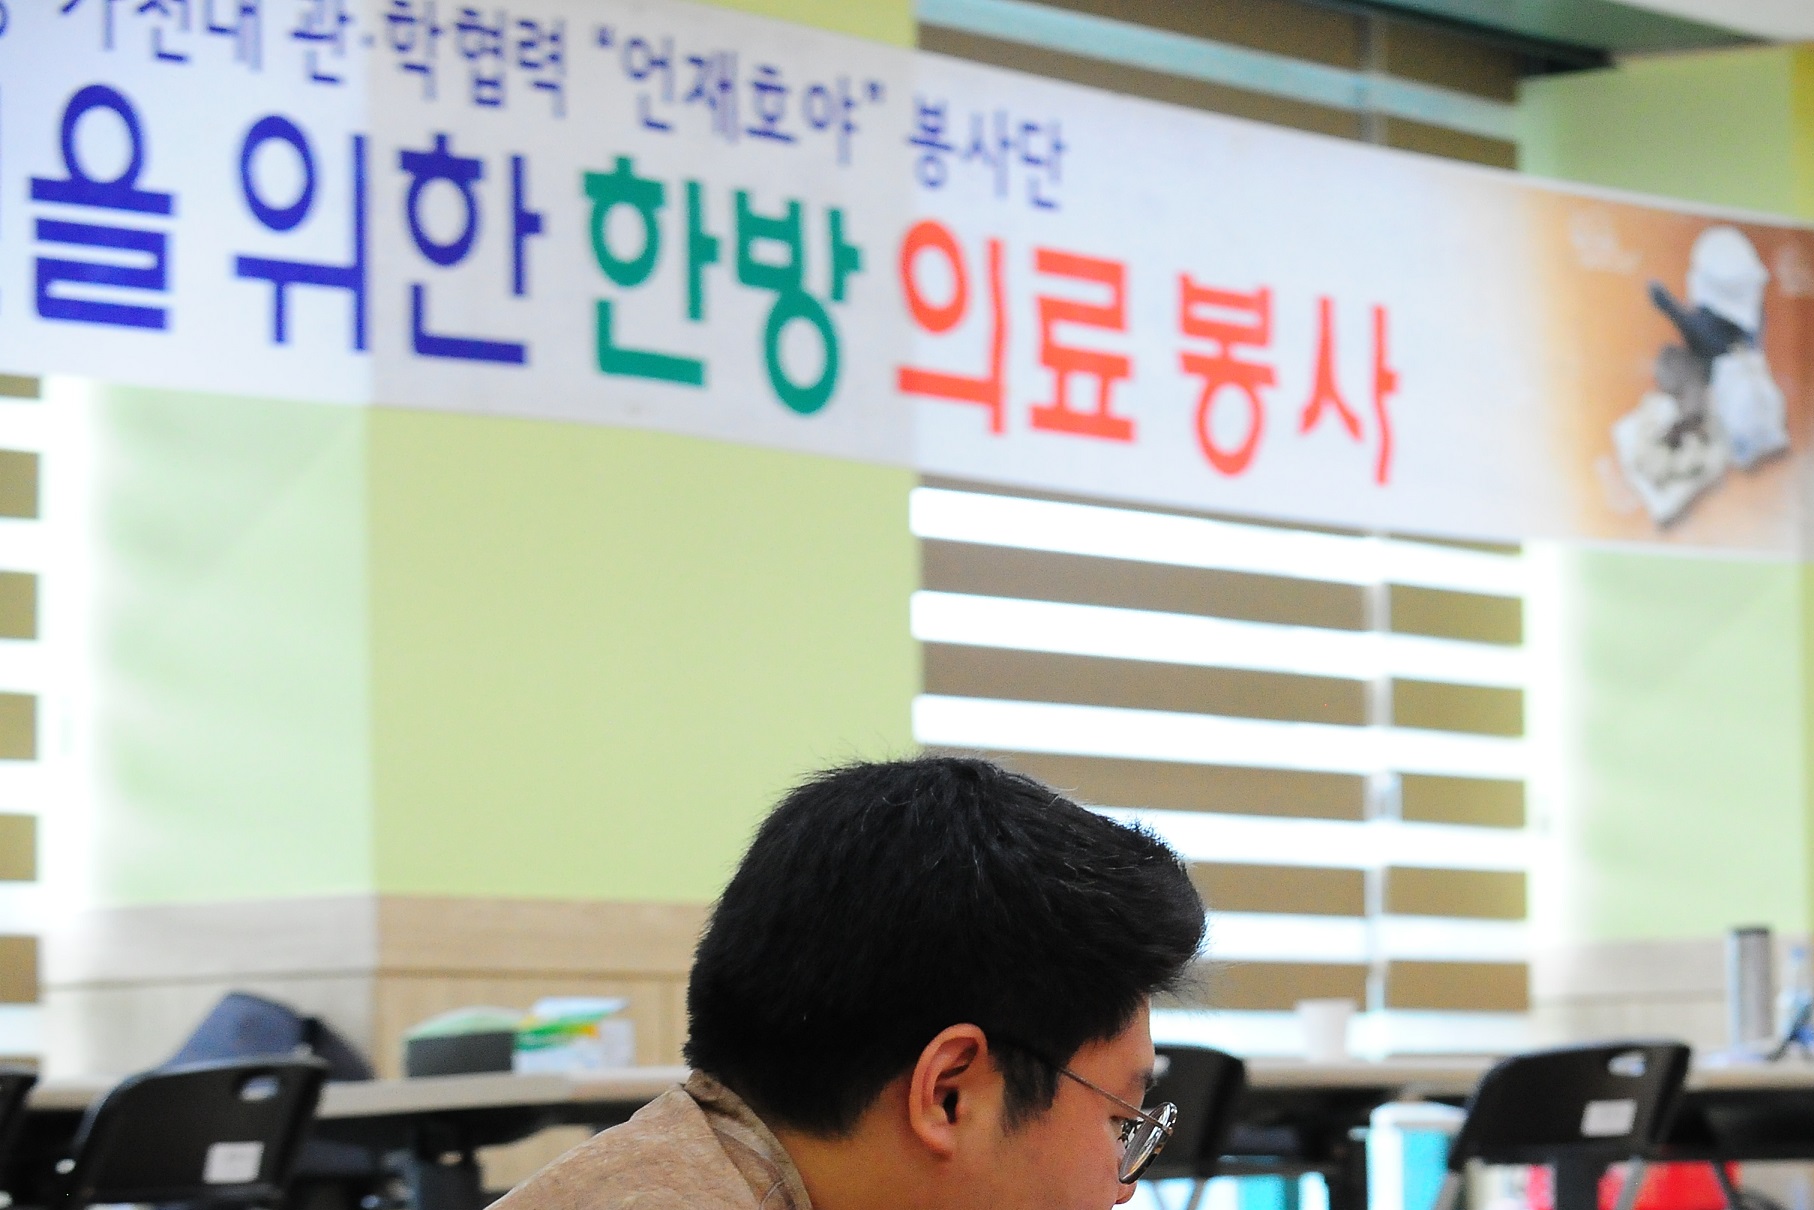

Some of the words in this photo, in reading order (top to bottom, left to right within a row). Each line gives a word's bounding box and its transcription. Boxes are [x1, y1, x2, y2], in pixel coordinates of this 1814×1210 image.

[27, 83, 177, 334] 을
[230, 113, 547, 369] 위한
[580, 154, 866, 419] 한방
[896, 219, 1137, 443] 의료
[1177, 273, 1400, 485] 봉사
[906, 98, 1068, 212] 봉사단
